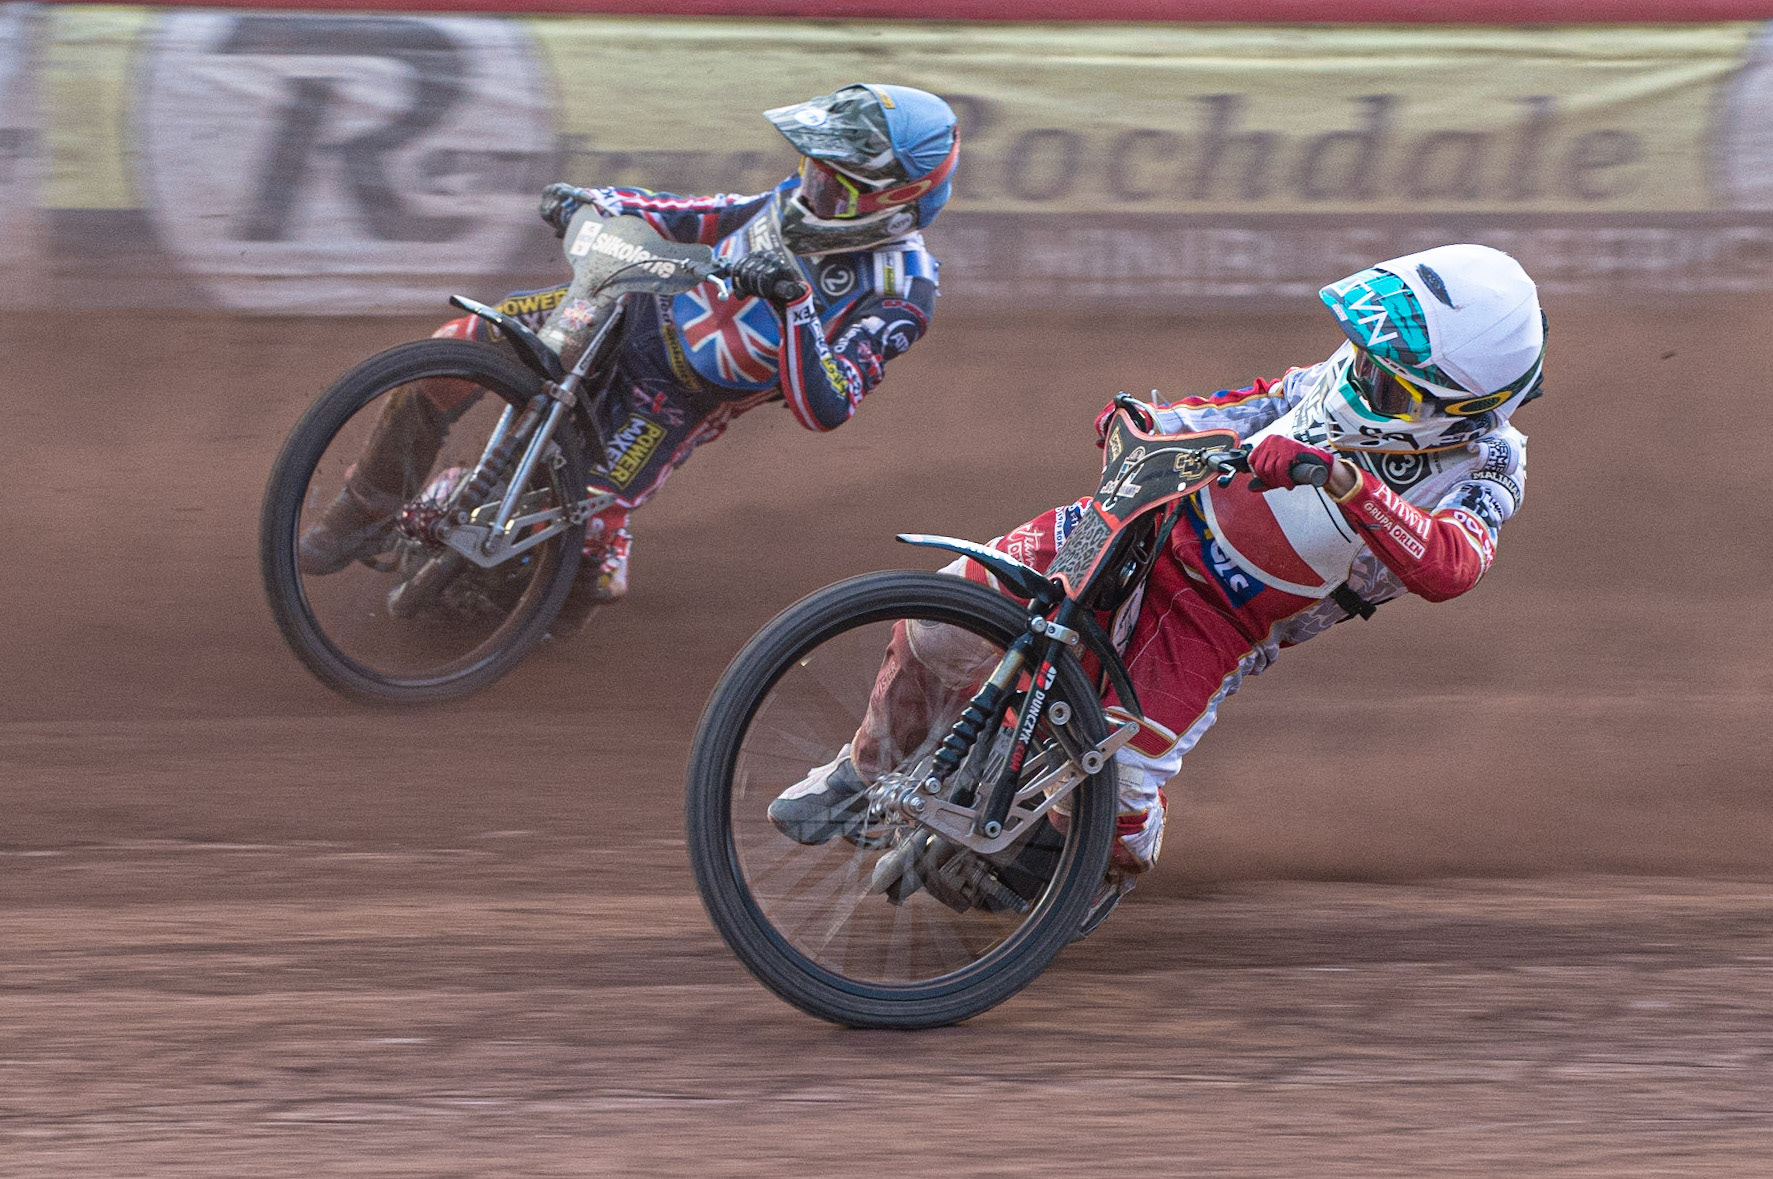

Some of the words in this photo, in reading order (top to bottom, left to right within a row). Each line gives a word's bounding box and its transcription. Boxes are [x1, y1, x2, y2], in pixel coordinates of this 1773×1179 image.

[824, 270, 849, 291] 2
[609, 421, 662, 482] POWER
[1363, 500, 1393, 531] GRUPA
[1392, 527, 1423, 556] ORLEN
[1372, 482, 1431, 541] Anwil
